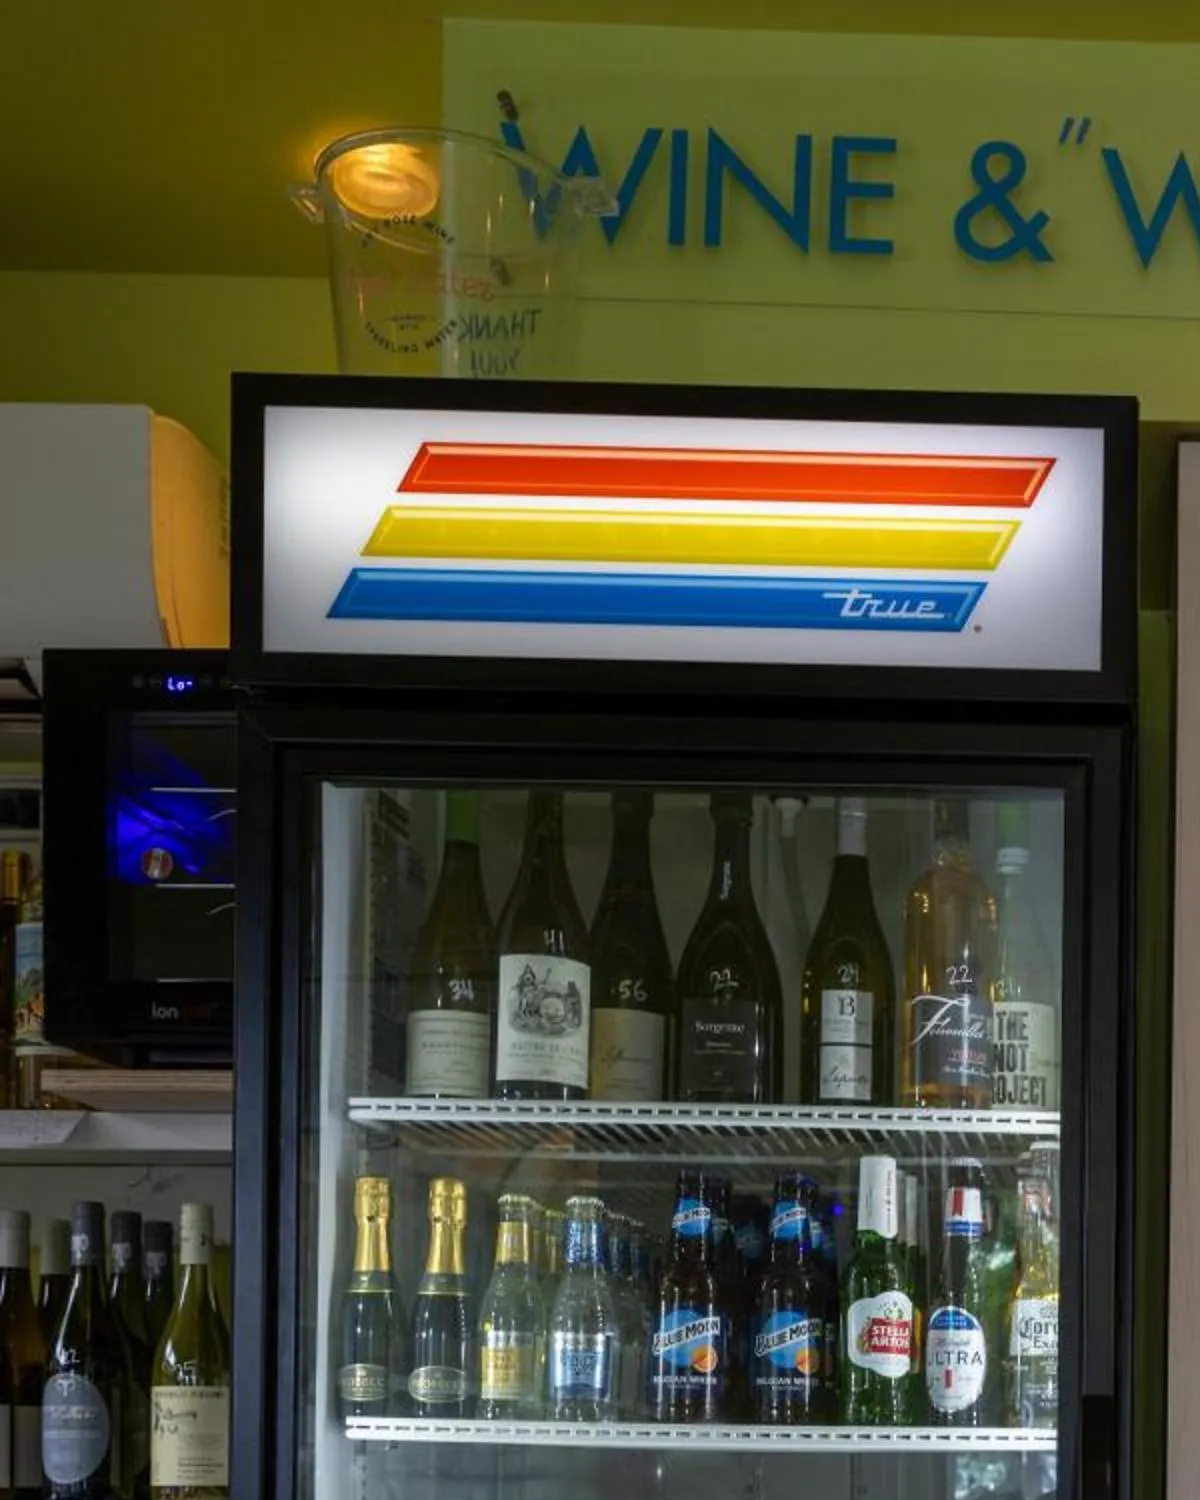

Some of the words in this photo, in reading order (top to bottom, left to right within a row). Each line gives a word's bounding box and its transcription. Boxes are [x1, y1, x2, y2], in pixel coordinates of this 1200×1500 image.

[499, 118, 898, 256] WINE
[954, 139, 1054, 263] &
[822, 586, 954, 620] true
[995, 1010, 1030, 1042] THE
[993, 1043, 1030, 1074] NOT
[991, 1074, 1047, 1108] OJECT
[653, 1328, 684, 1353] BLUE
[684, 1317, 721, 1341] MOON
[755, 1329, 789, 1355] BLUE
[926, 1349, 984, 1367] ULTRA
